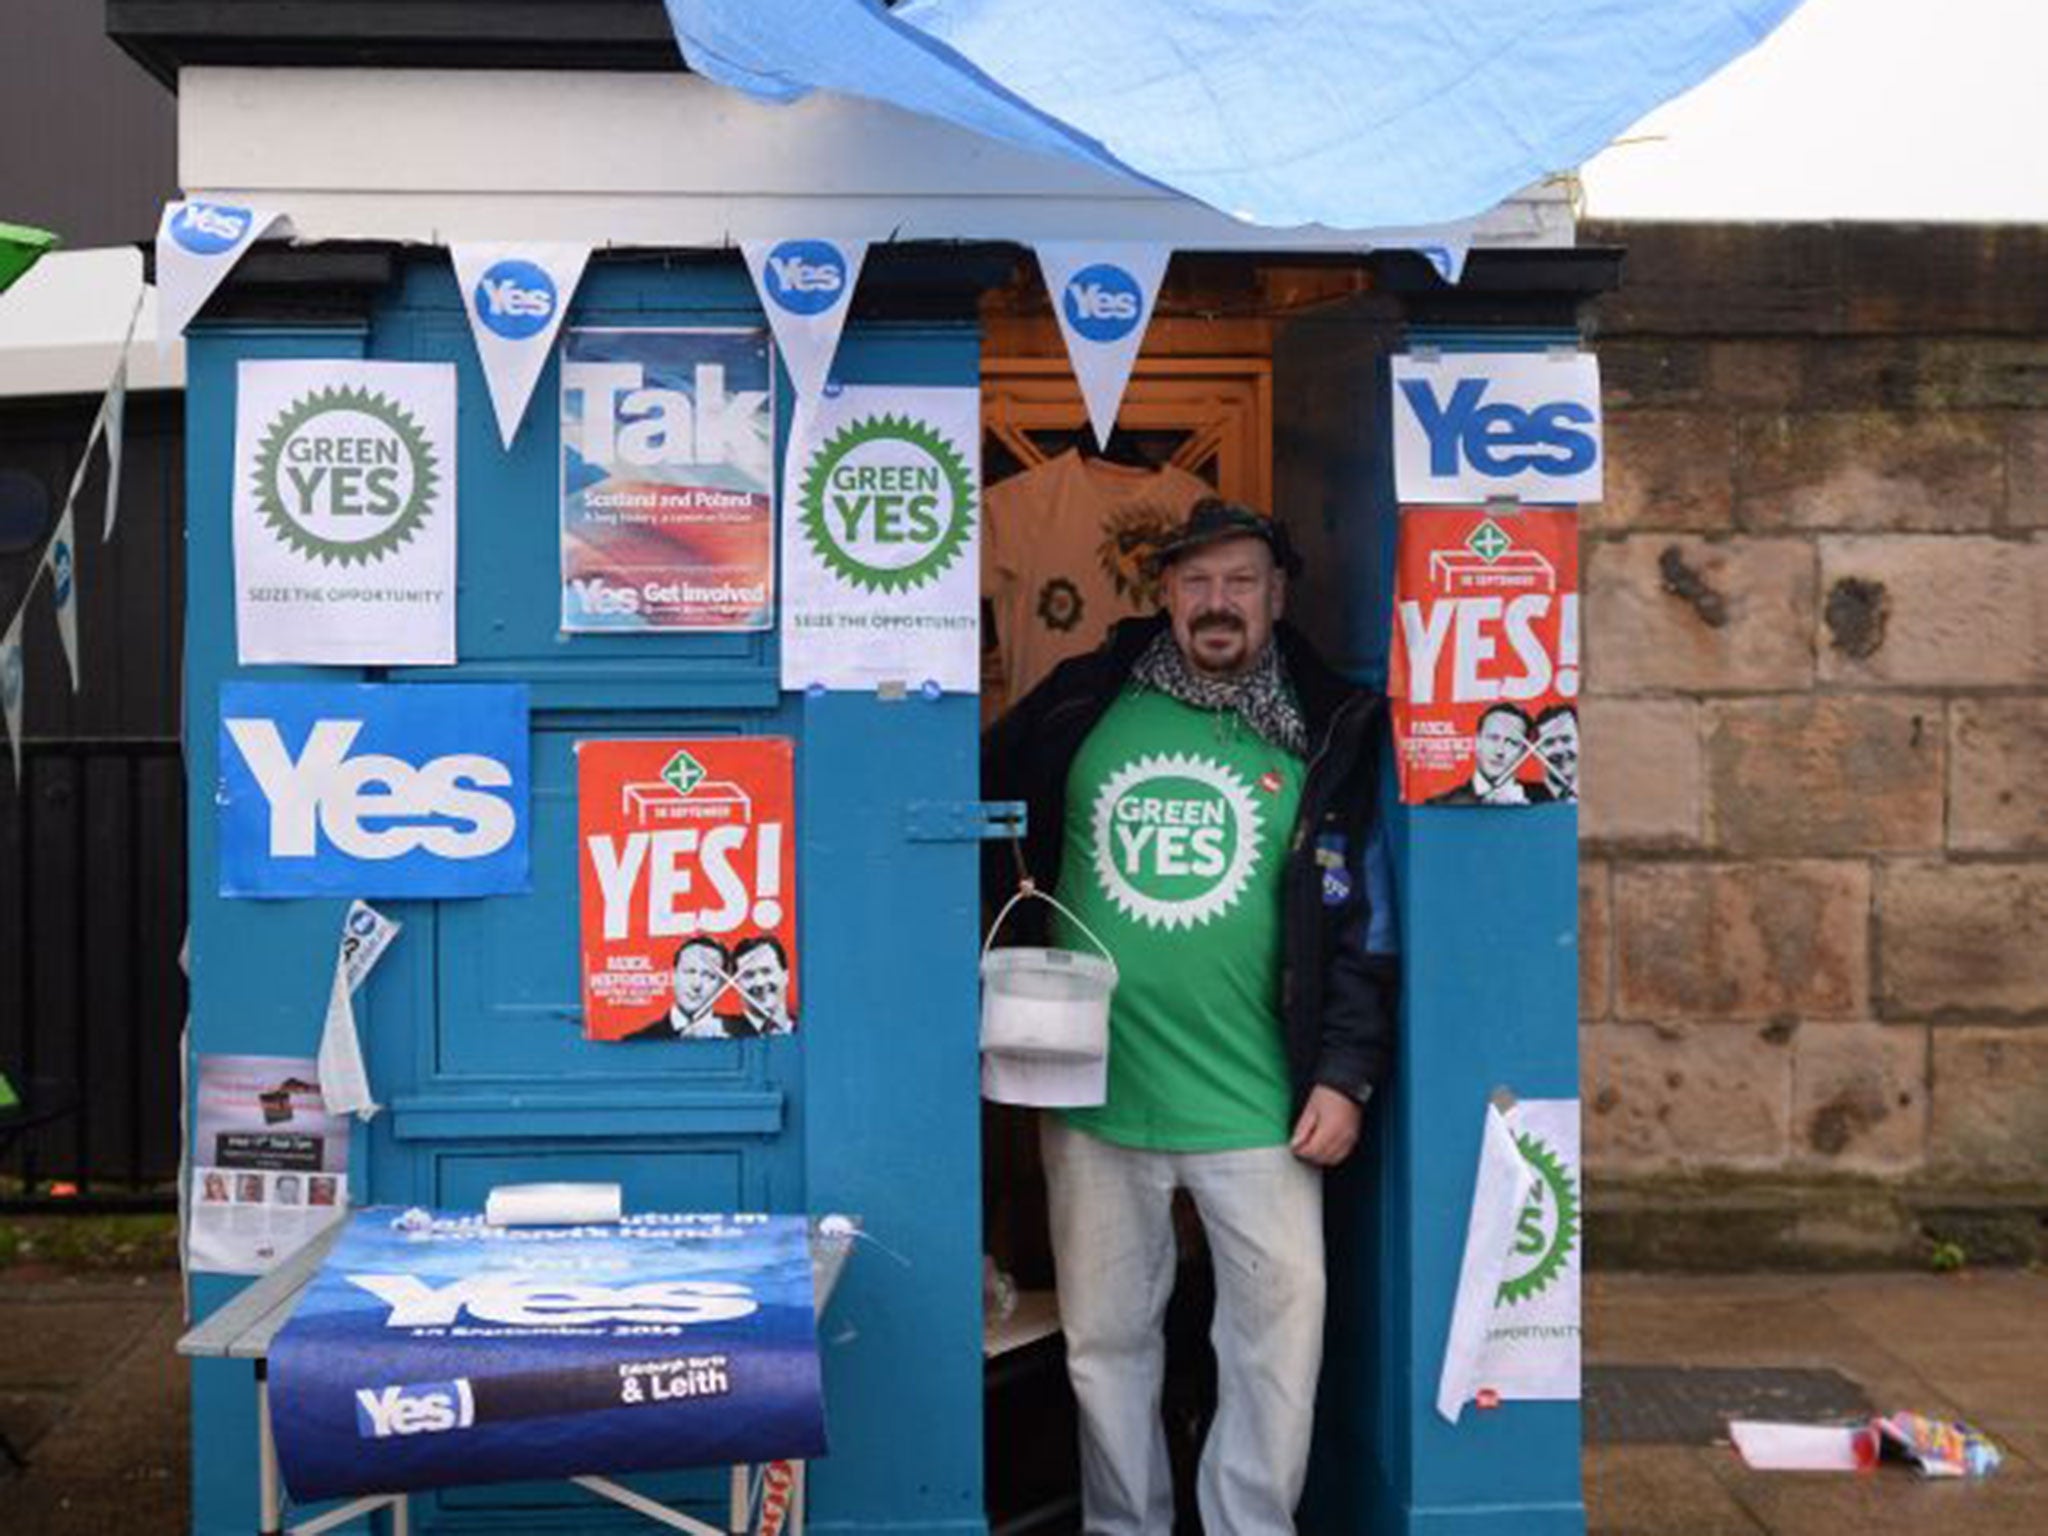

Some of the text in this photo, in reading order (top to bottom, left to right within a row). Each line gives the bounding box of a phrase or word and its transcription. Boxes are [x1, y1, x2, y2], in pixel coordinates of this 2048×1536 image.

[182, 200, 246, 240] Yes
[767, 254, 843, 294] Yes
[480, 275, 552, 318] Yes
[1065, 281, 1137, 320] Yes
[565, 361, 769, 468] Tak
[1397, 378, 1597, 477] Yes
[288, 437, 398, 465] GREEN
[285, 467, 400, 517] YES
[833, 466, 939, 492] GREEN
[584, 491, 752, 508] Scotland and Poland
[833, 495, 939, 543] YES
[249, 588, 444, 603] SEIZE THE OPPORTUNITY
[572, 578, 641, 614] Yes
[643, 582, 680, 603] Get
[794, 614, 833, 627] SEIZE
[838, 614, 867, 627] THE
[1400, 593, 1578, 704] YES!
[223, 718, 516, 860] Yes
[1115, 796, 1225, 825] GREEN
[1115, 825, 1225, 876] YES
[587, 823, 782, 939] YES!
[347, 1275, 758, 1326] Yes
[621, 1369, 728, 1403] & Leith
[356, 1387, 456, 1437] Yes
